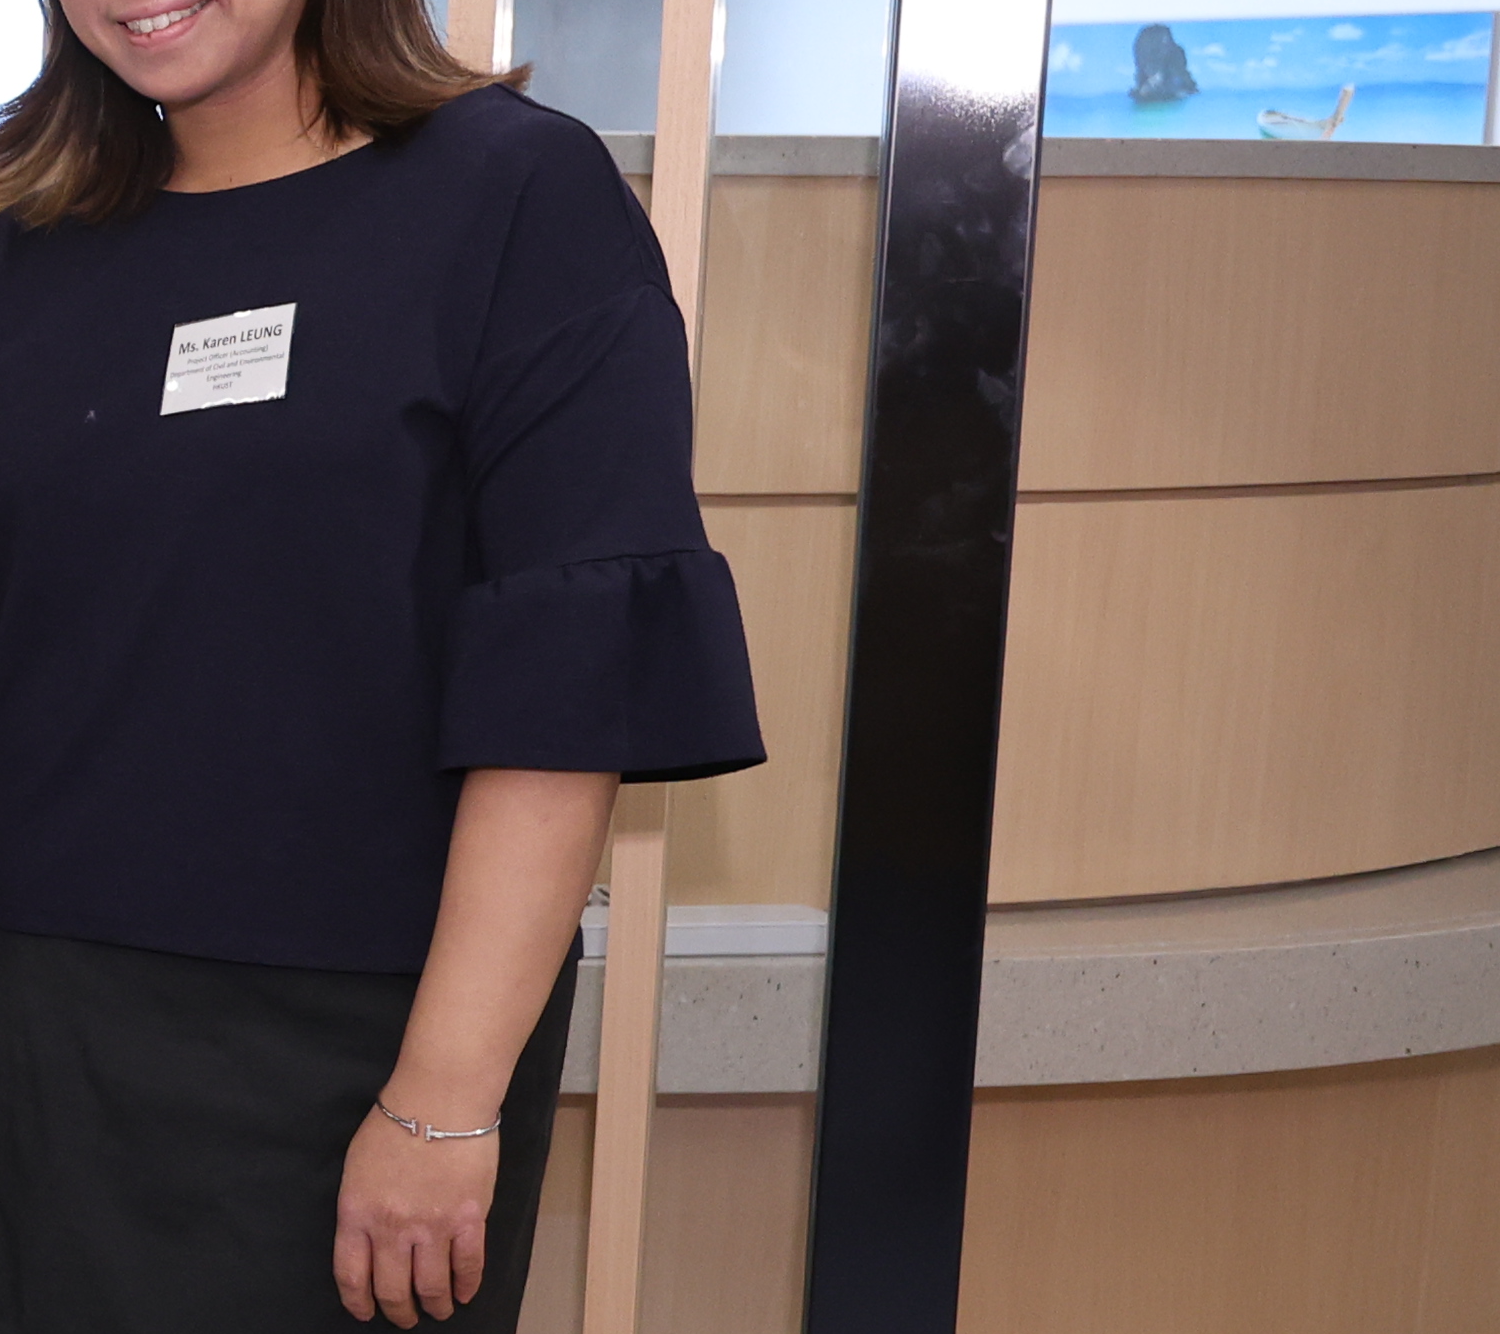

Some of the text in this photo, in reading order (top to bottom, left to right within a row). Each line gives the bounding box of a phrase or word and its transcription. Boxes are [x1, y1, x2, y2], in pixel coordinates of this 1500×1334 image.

[179, 324, 283, 355] Ms. Karen LEUNG
